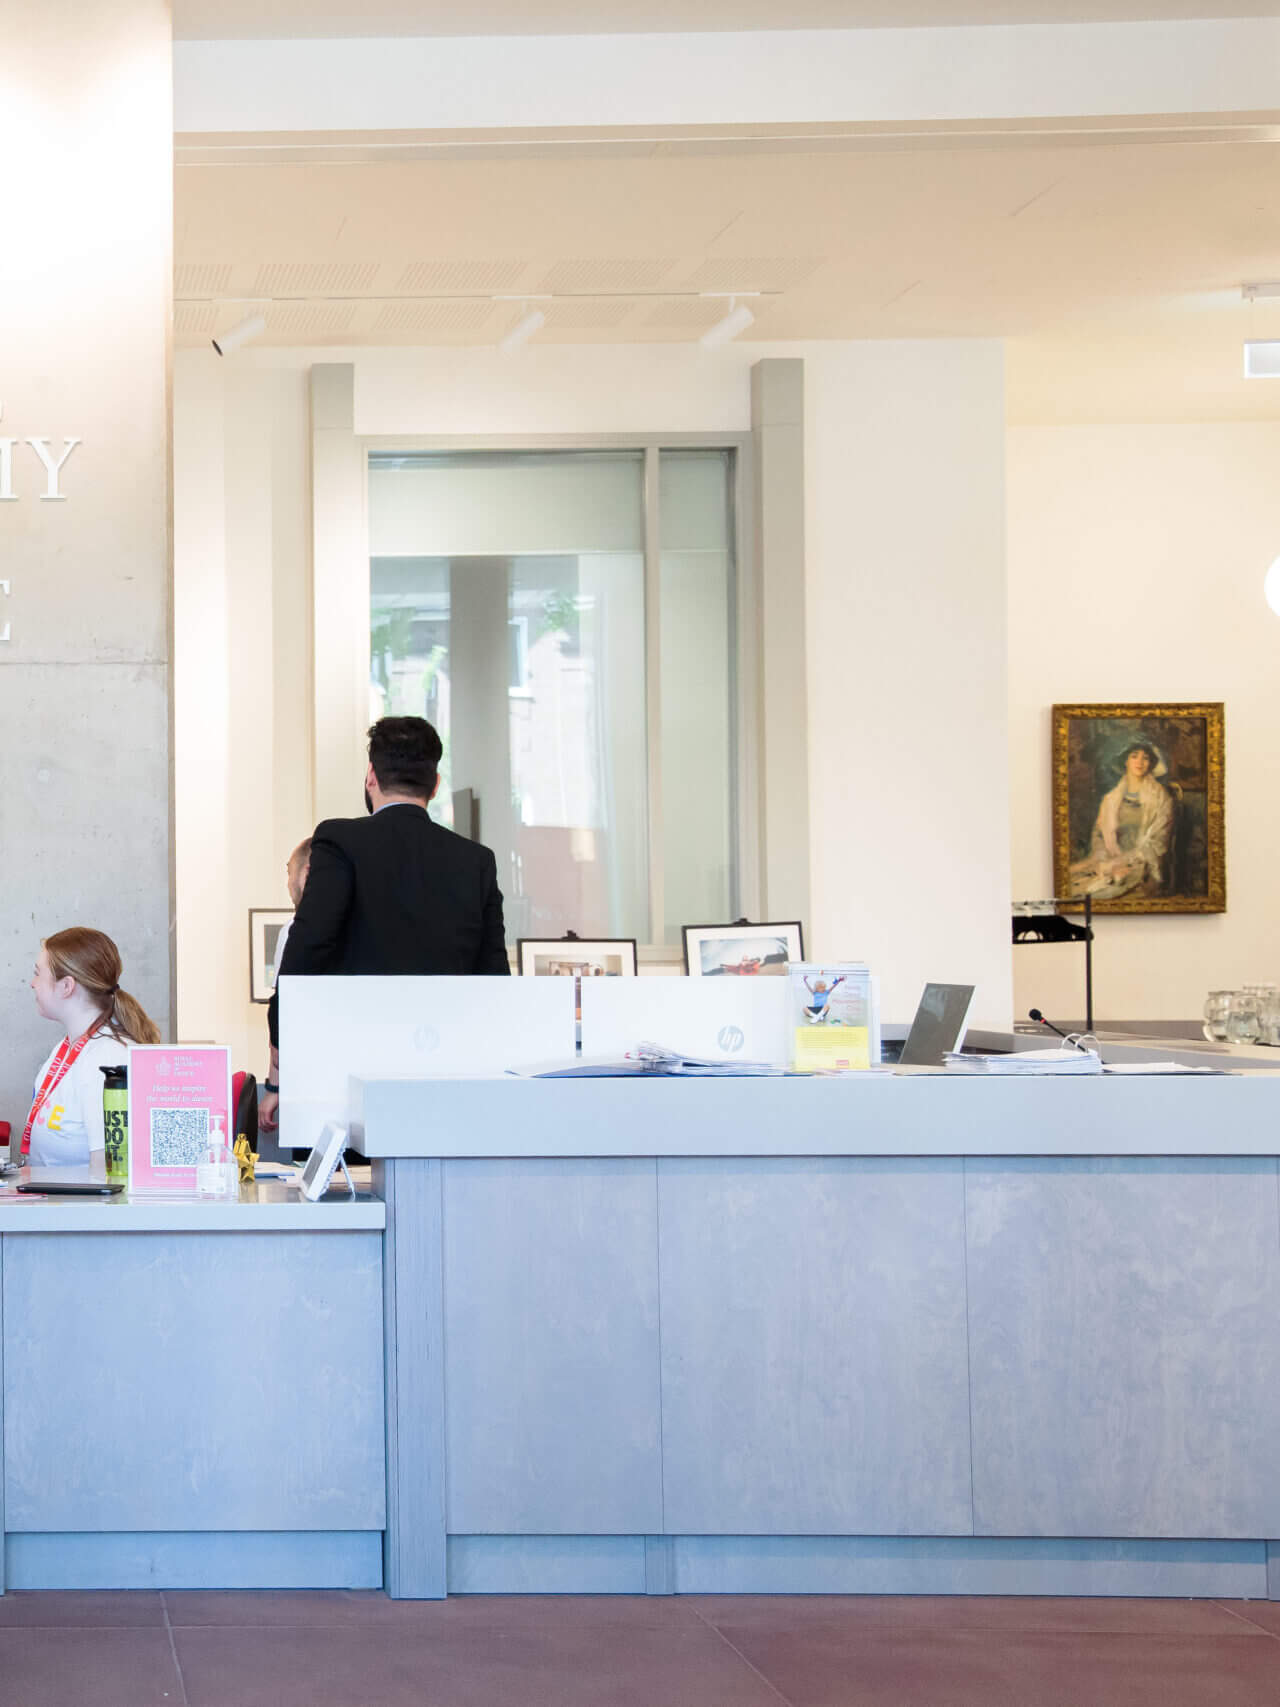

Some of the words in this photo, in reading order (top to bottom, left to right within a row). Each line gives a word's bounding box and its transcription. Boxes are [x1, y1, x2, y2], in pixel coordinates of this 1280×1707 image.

[718, 1025, 744, 1052] hp
[47, 1057, 61, 1077] RAD
[104, 1110, 128, 1127] UST
[104, 1127, 124, 1144] DO
